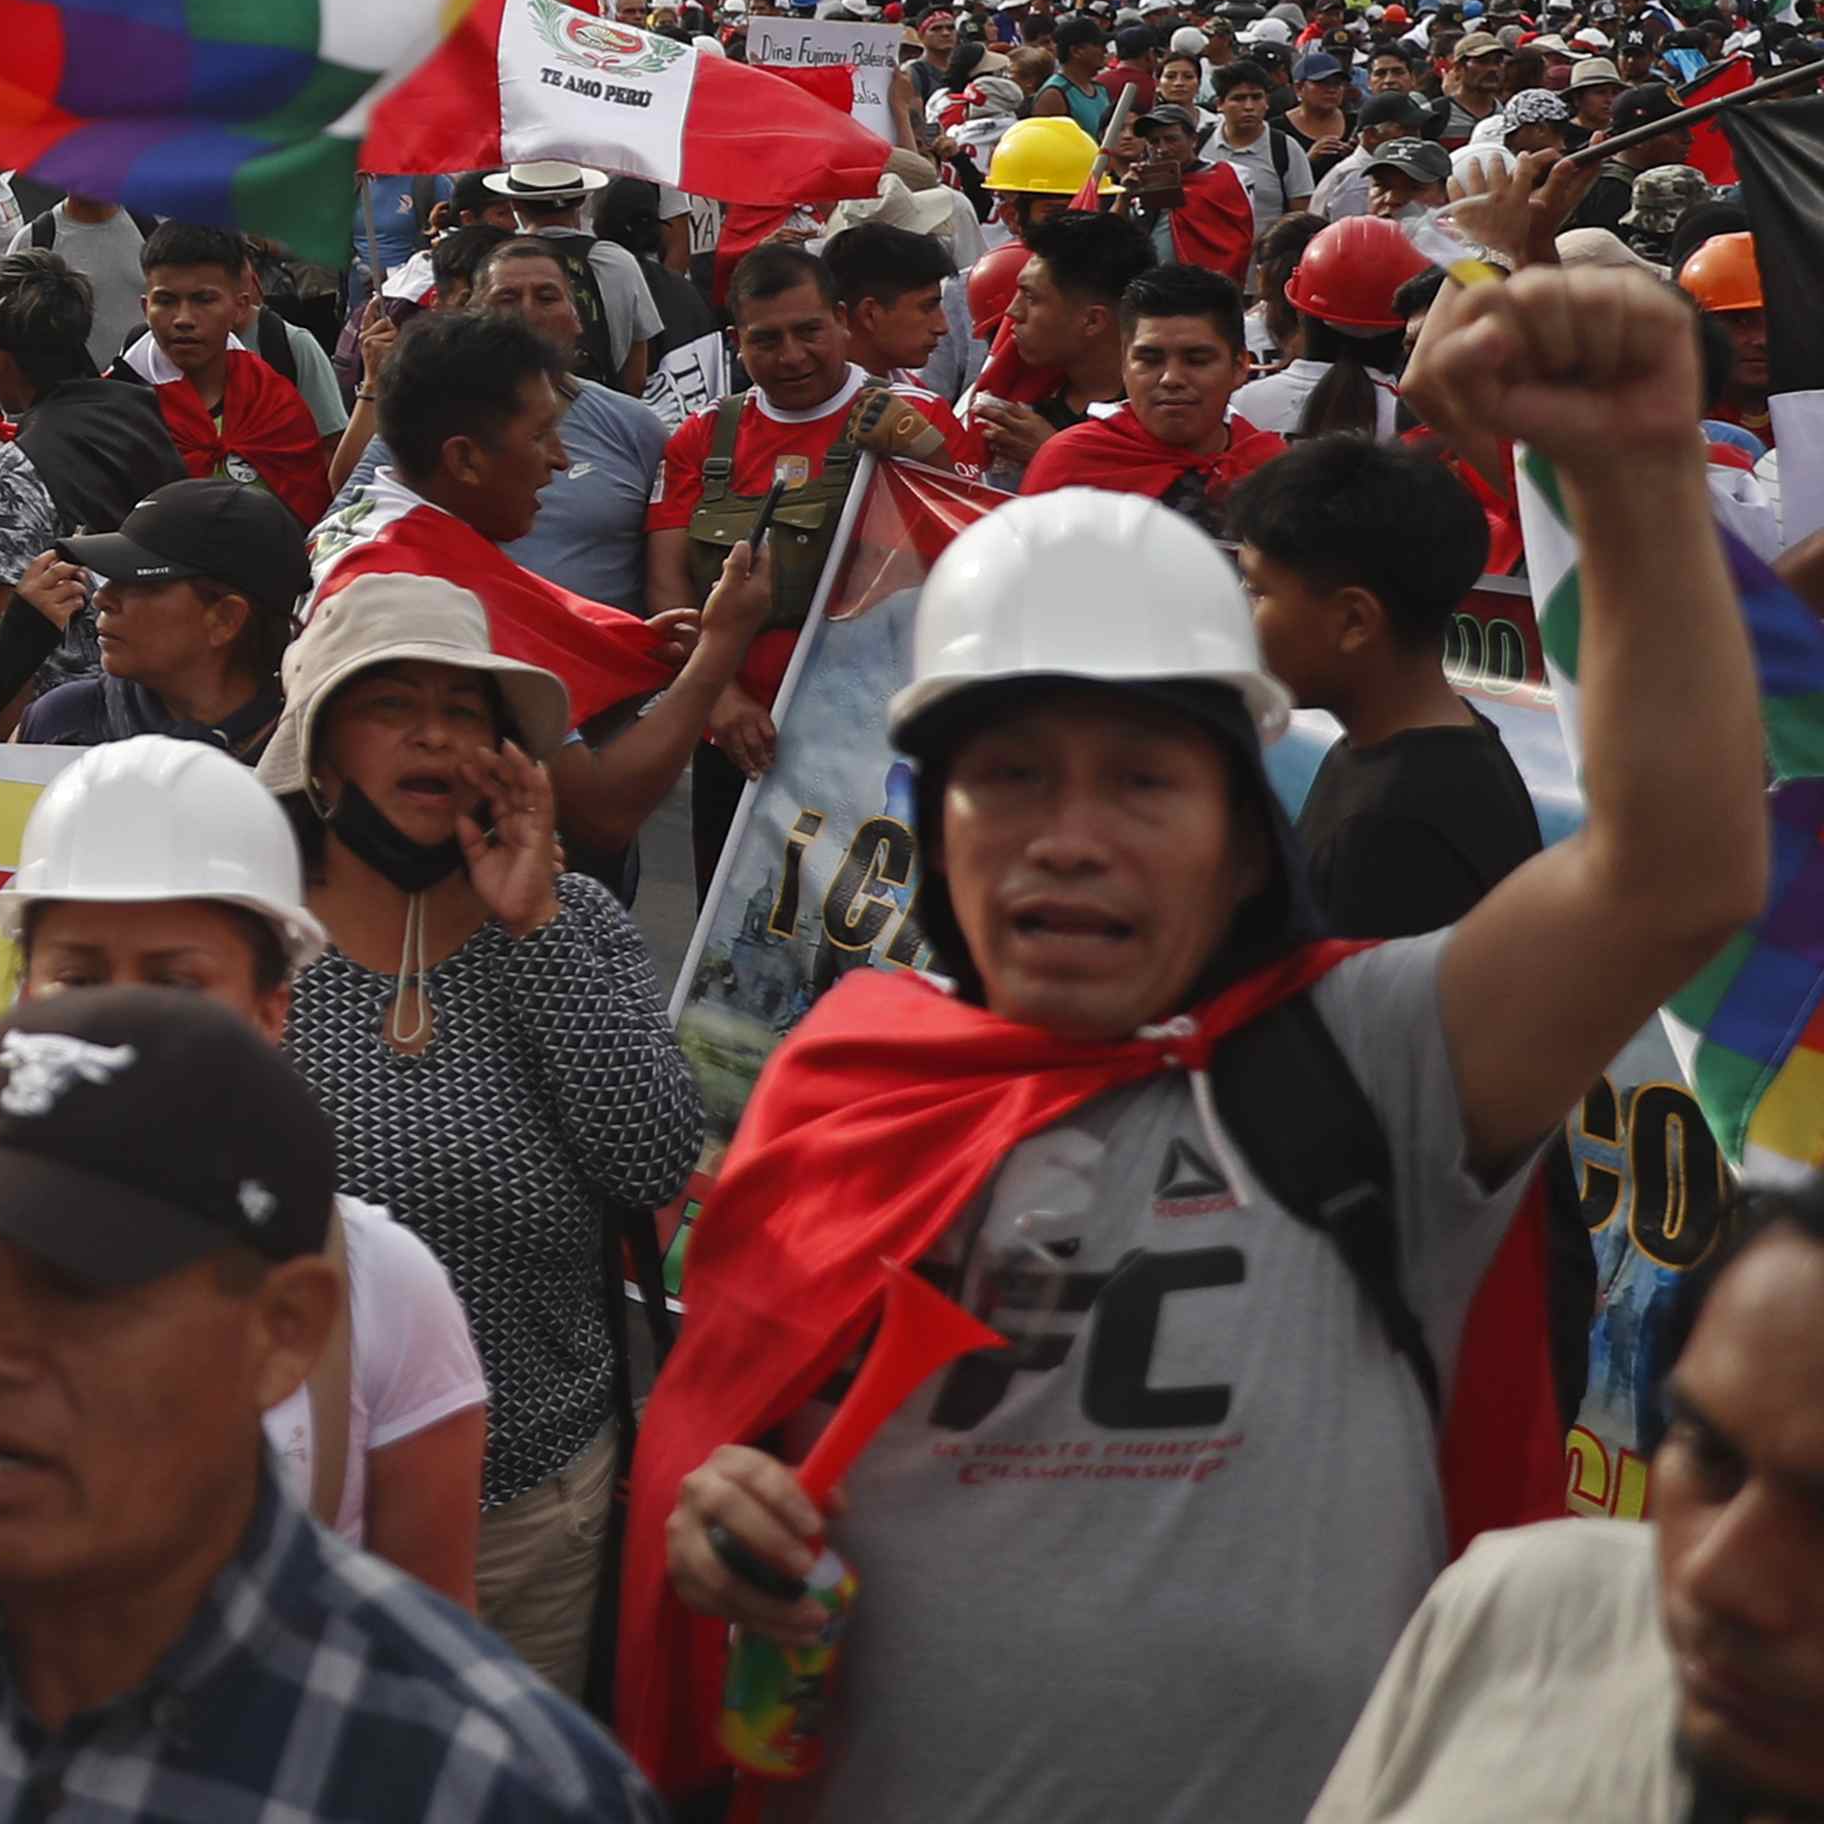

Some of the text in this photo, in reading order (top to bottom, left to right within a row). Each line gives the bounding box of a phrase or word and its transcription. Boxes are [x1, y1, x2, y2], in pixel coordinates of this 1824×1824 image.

[761, 33, 792, 62] Dina
[540, 67, 563, 86] TE
[563, 75, 602, 98] AMO
[929, 1246, 1245, 1432] FC
[958, 1458, 1232, 1484] CHAMPIONSHIP
